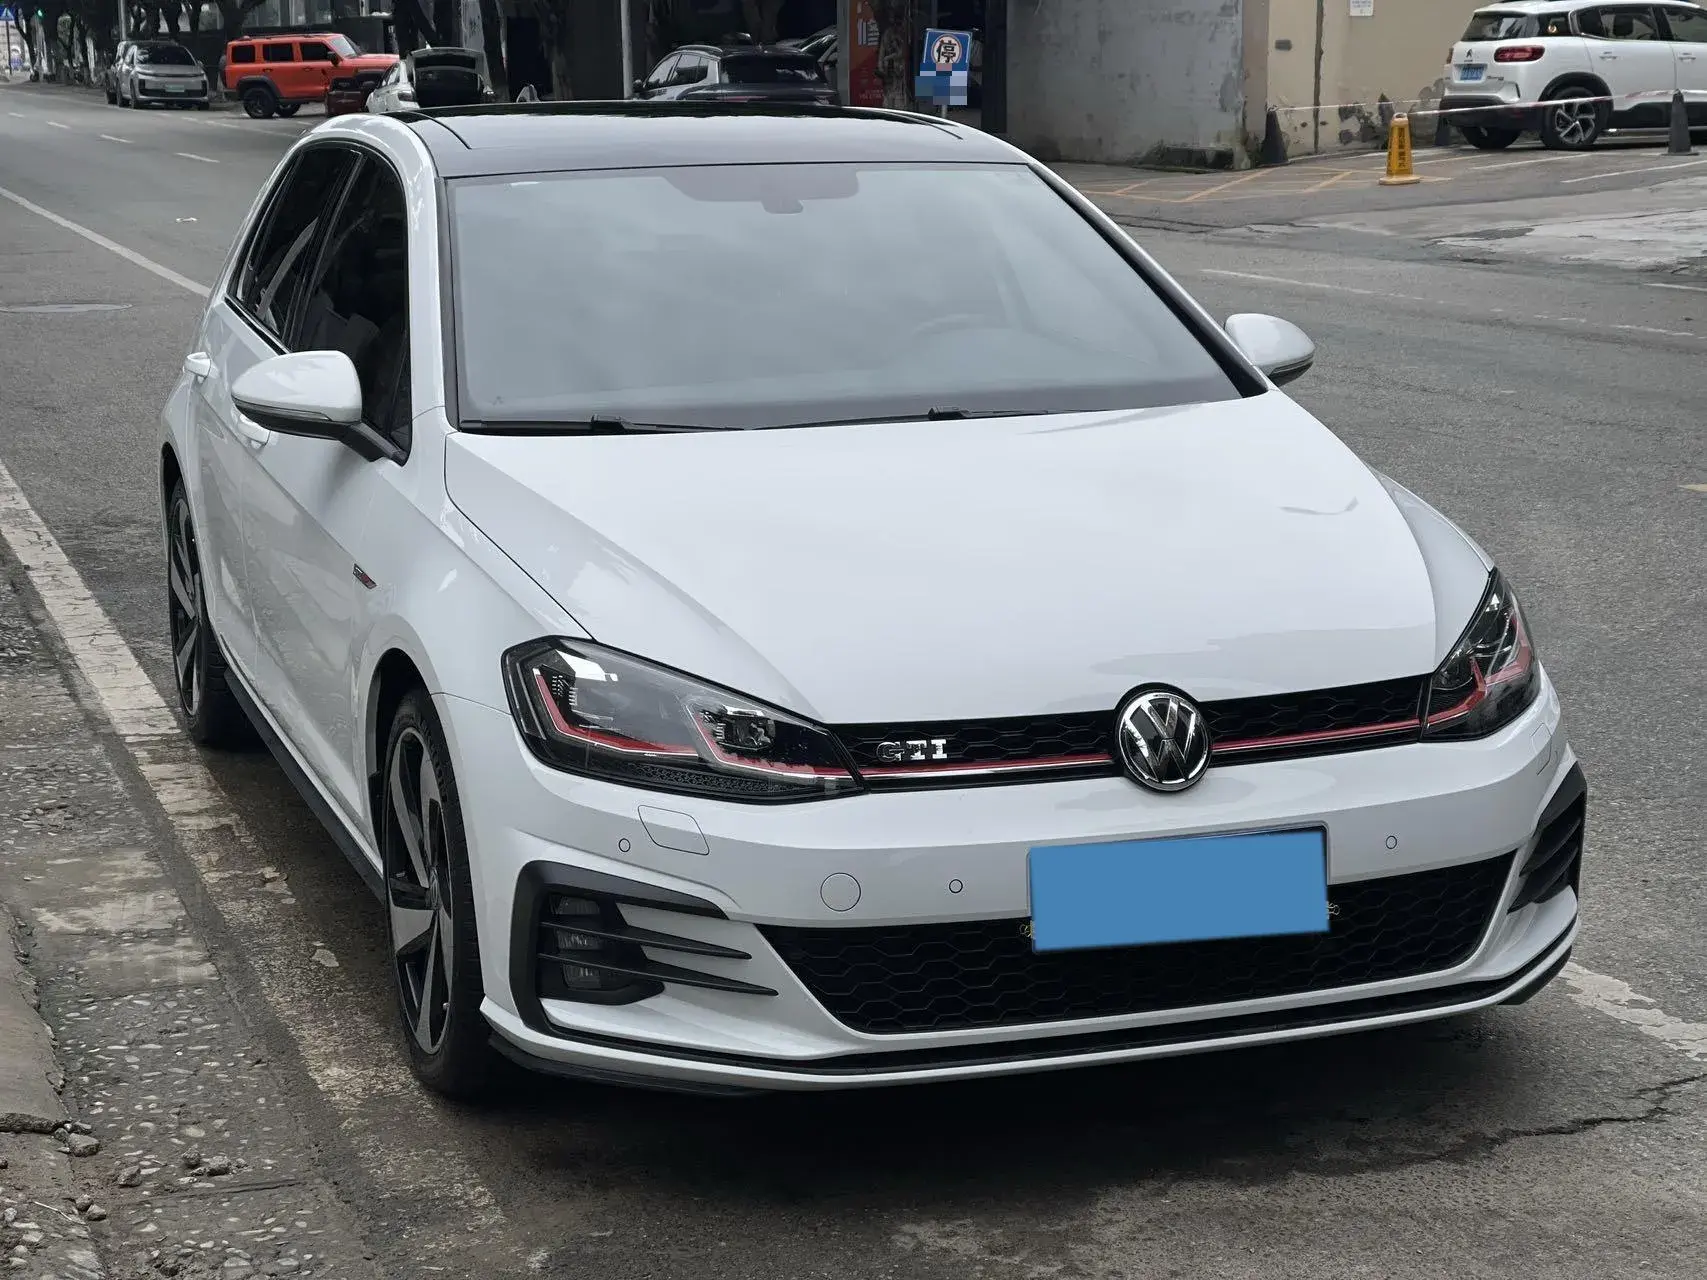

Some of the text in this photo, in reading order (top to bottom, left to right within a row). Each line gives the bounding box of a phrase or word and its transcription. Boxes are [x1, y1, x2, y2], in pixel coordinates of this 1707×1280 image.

[936, 40, 957, 63] 停
[876, 739, 948, 762] GTI
[1119, 692, 1207, 788] VW
